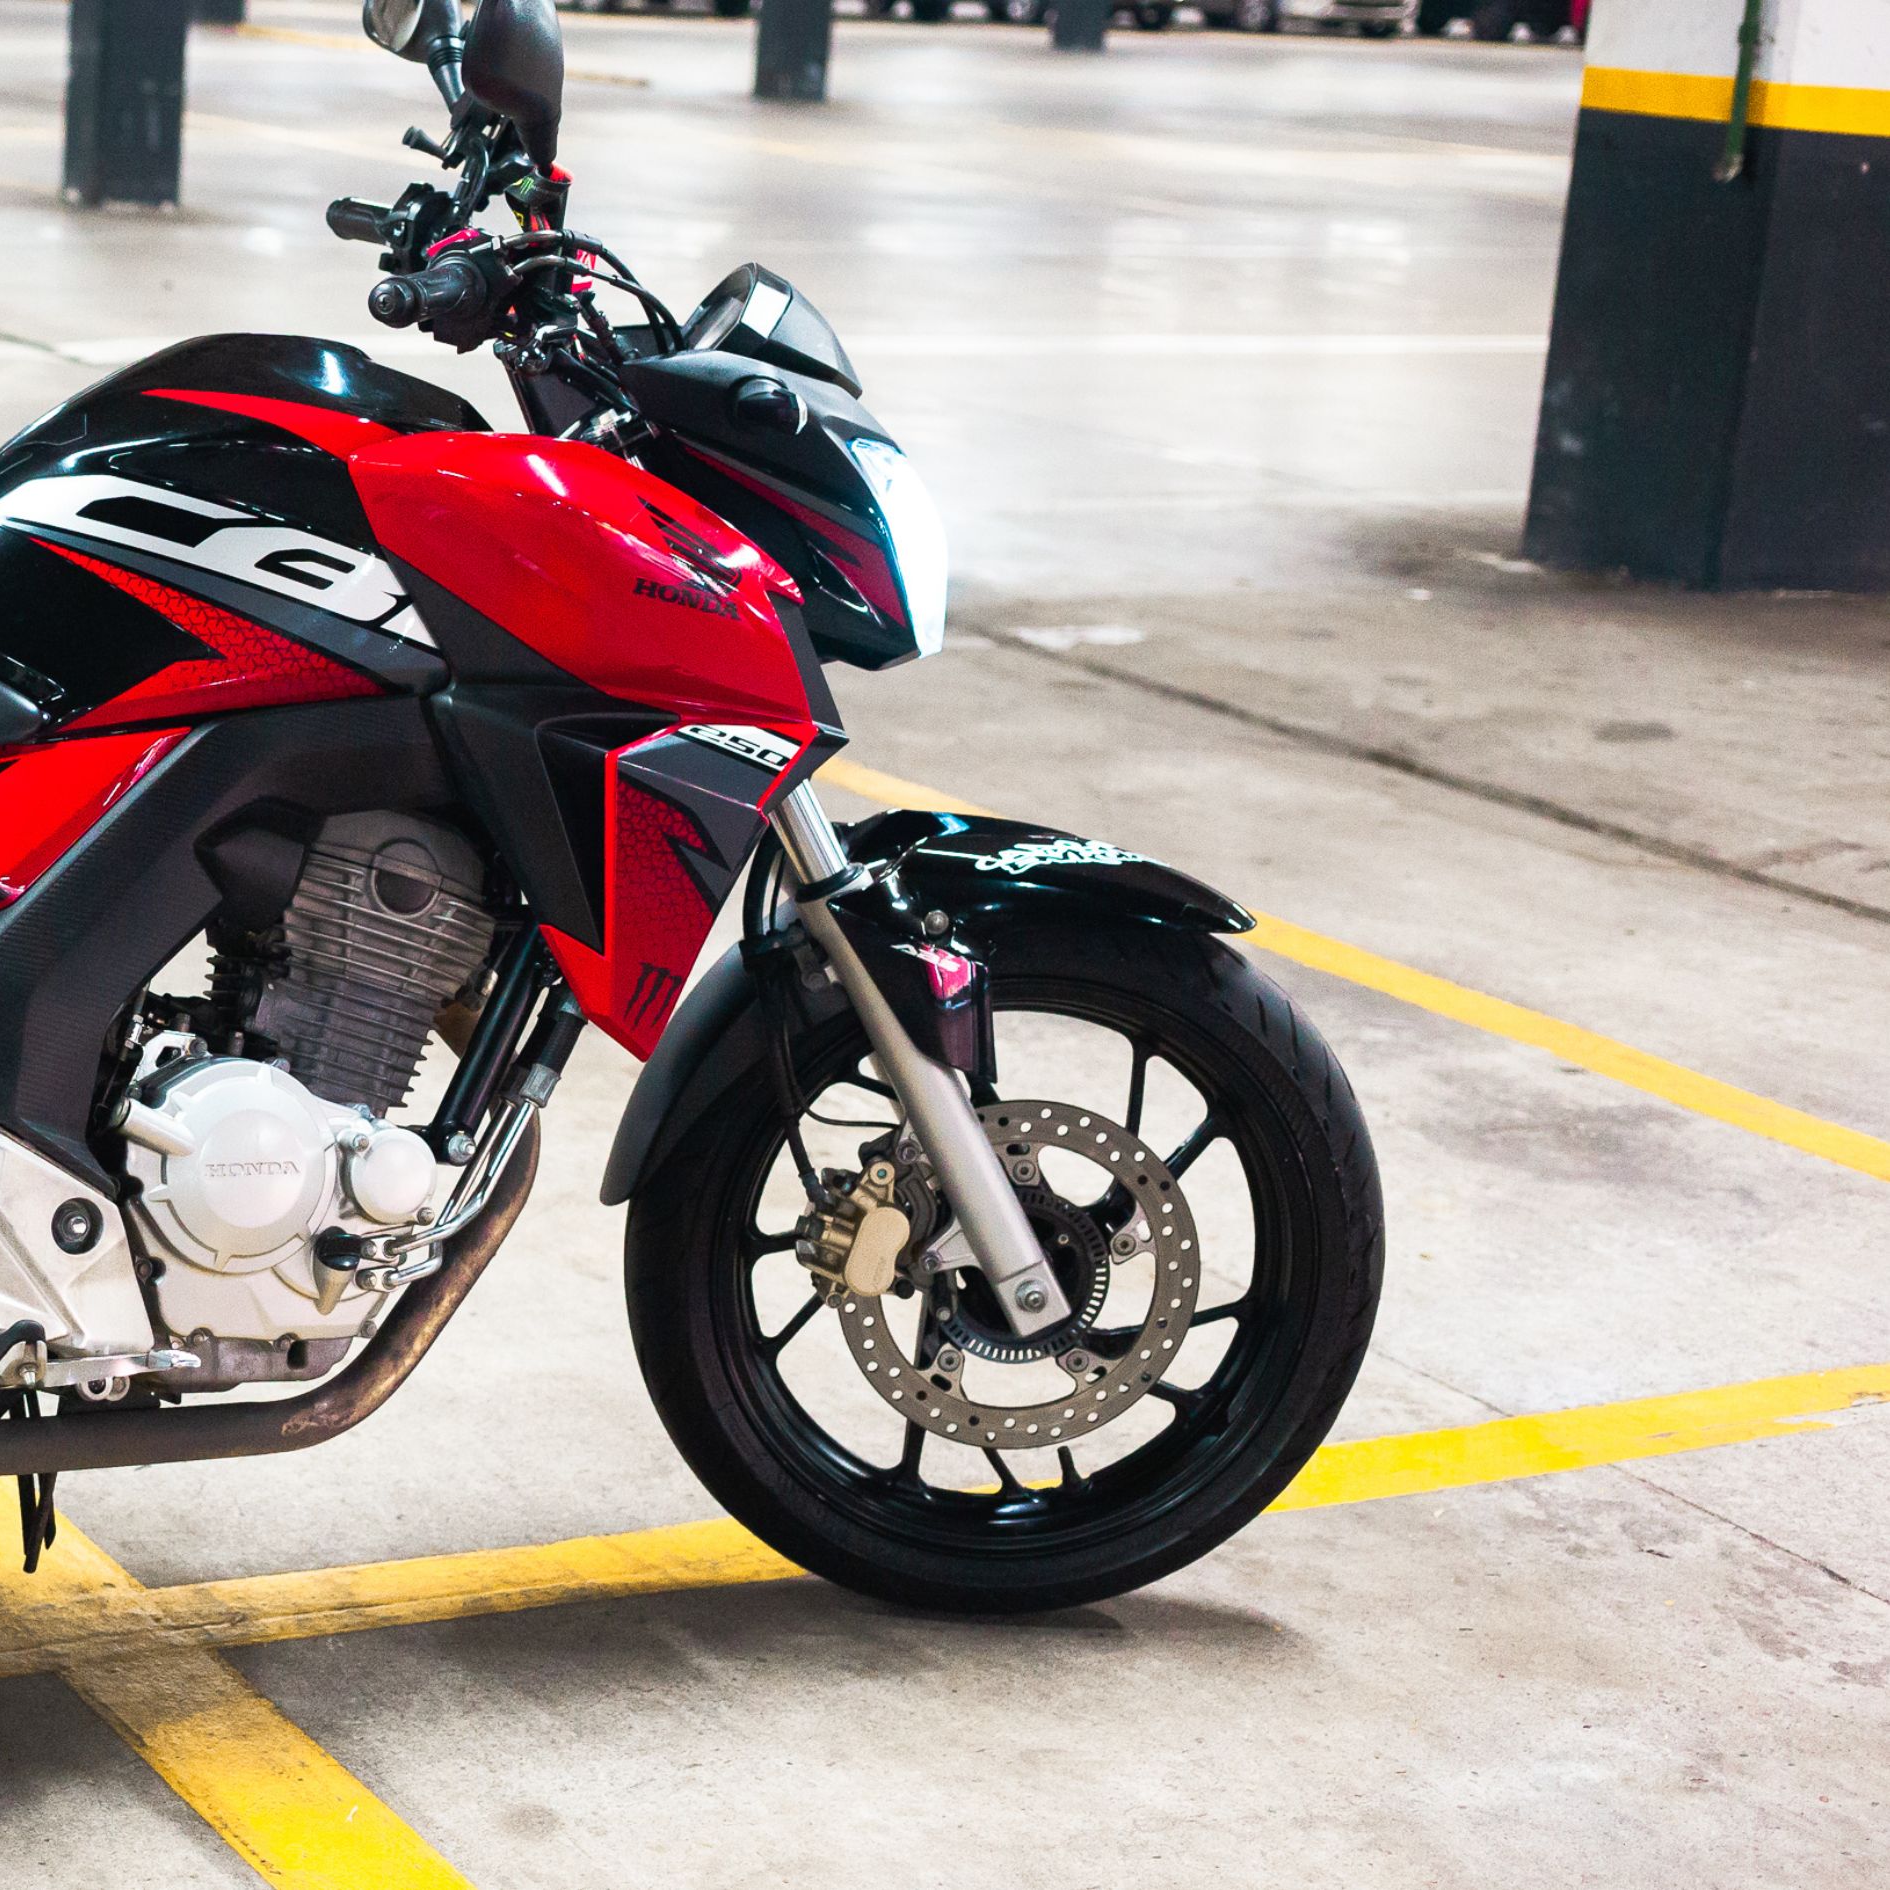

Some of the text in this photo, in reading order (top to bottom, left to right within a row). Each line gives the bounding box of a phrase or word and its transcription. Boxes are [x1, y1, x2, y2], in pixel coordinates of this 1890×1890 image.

[633, 577, 741, 622] HONDA
[688, 725, 790, 767] 250
[205, 1160, 300, 1177] HONDA
